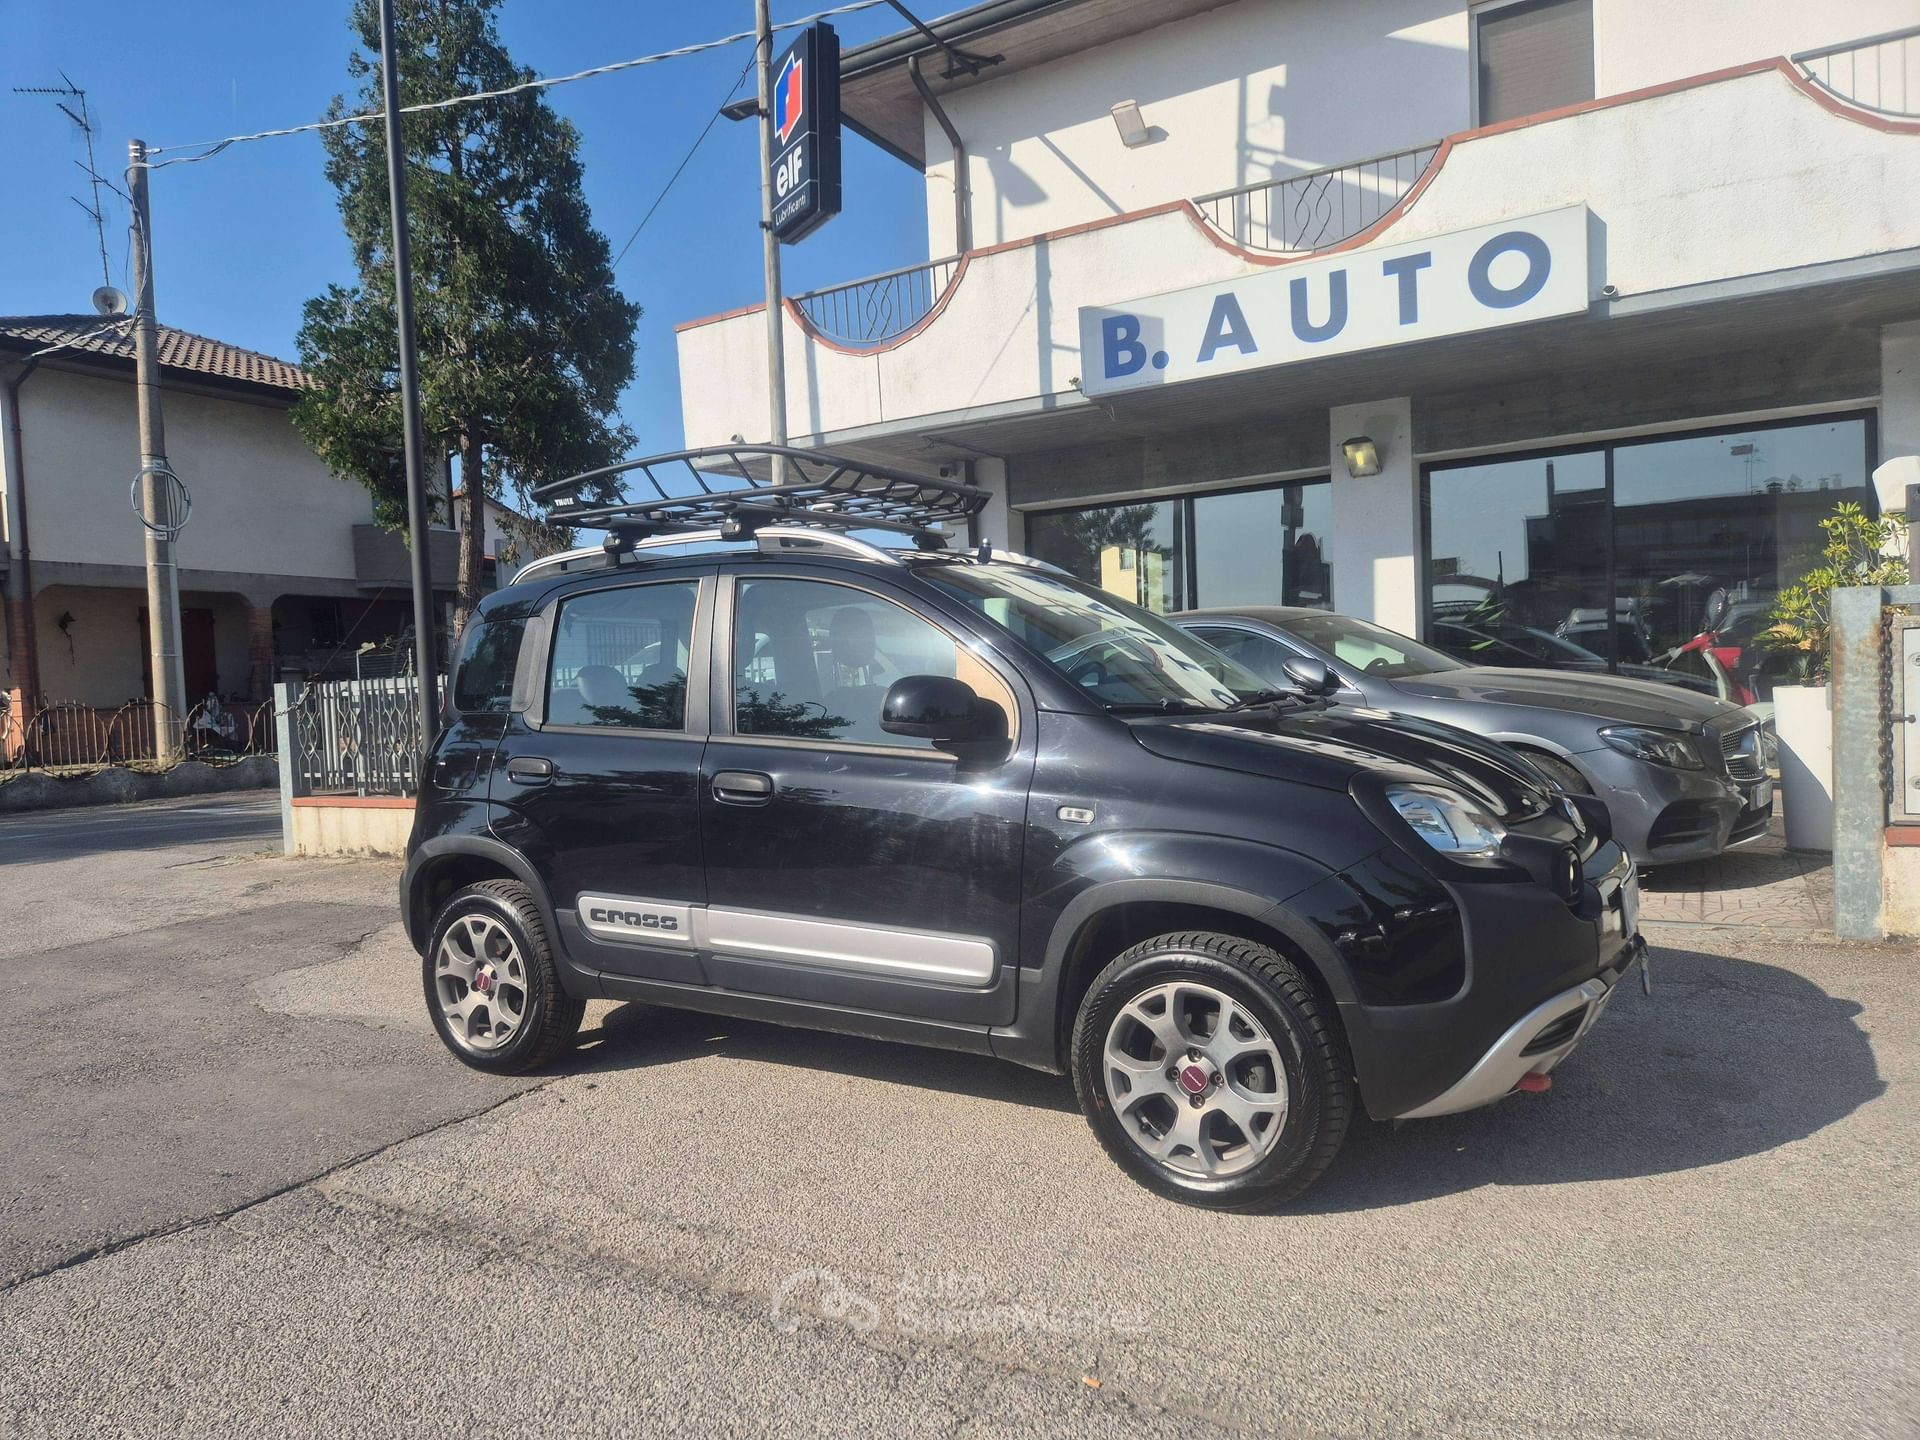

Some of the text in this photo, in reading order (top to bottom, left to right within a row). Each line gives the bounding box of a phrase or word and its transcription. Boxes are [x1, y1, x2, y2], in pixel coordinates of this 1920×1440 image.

[776, 145, 802, 198] elf
[775, 192, 806, 226] Lubrificanti
[1101, 230, 1551, 379] B. AUTO
